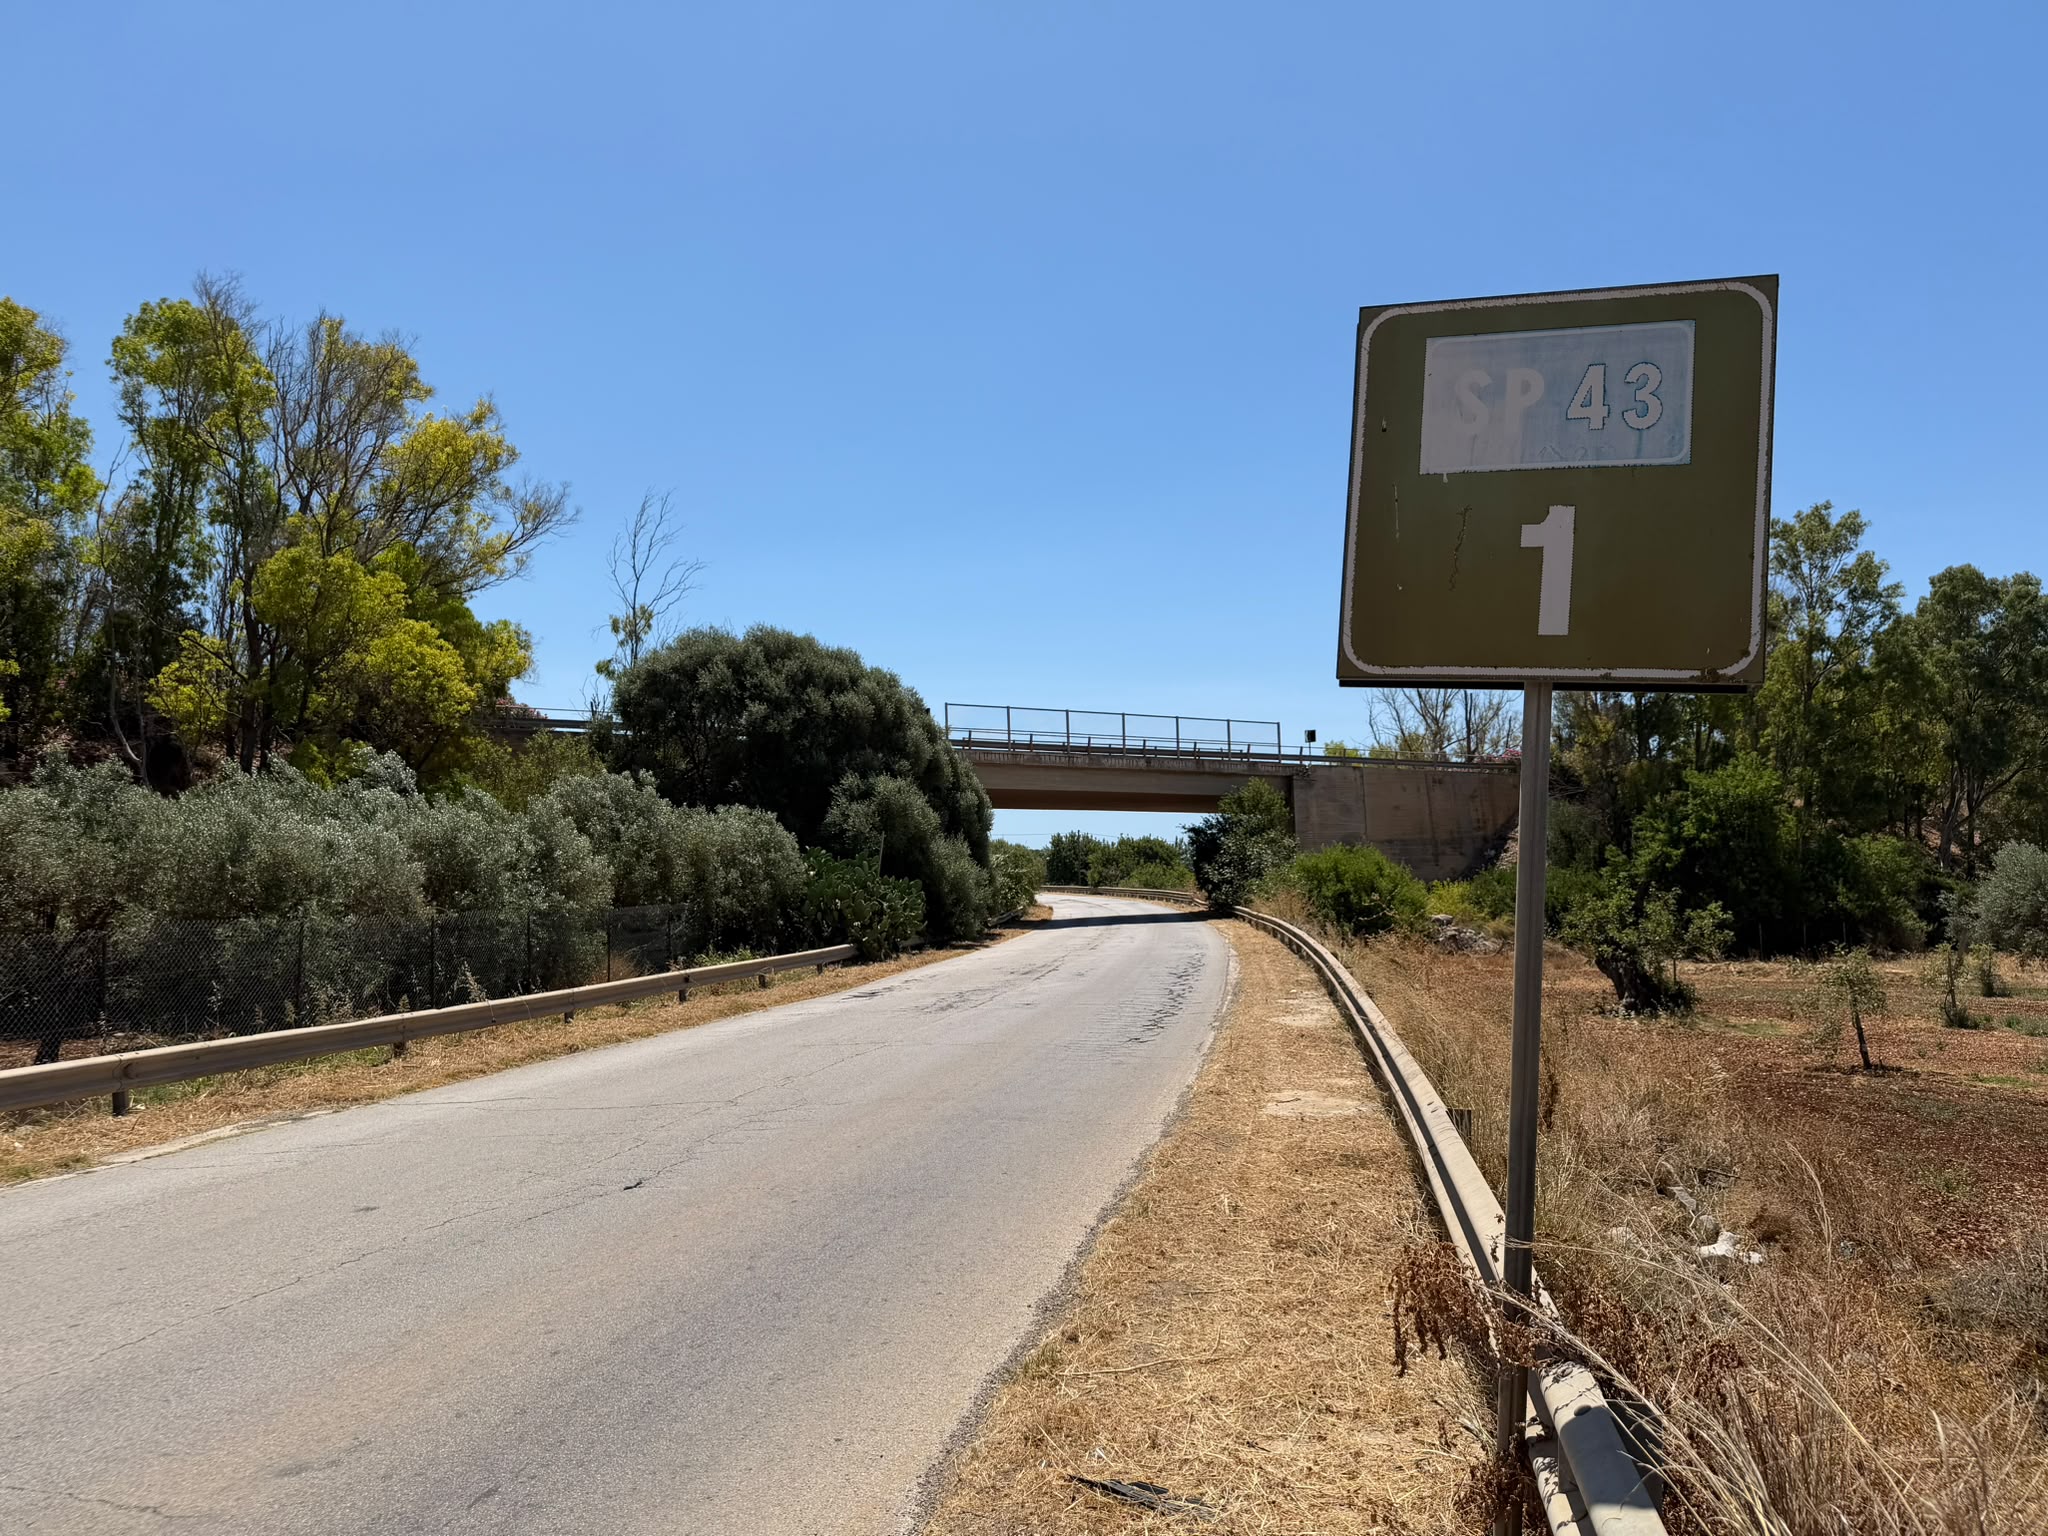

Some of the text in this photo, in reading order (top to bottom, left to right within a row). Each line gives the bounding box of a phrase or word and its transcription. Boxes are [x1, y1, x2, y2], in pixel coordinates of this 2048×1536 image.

[1454, 361, 1664, 434] SP 43
[1520, 504, 1576, 636] 1
